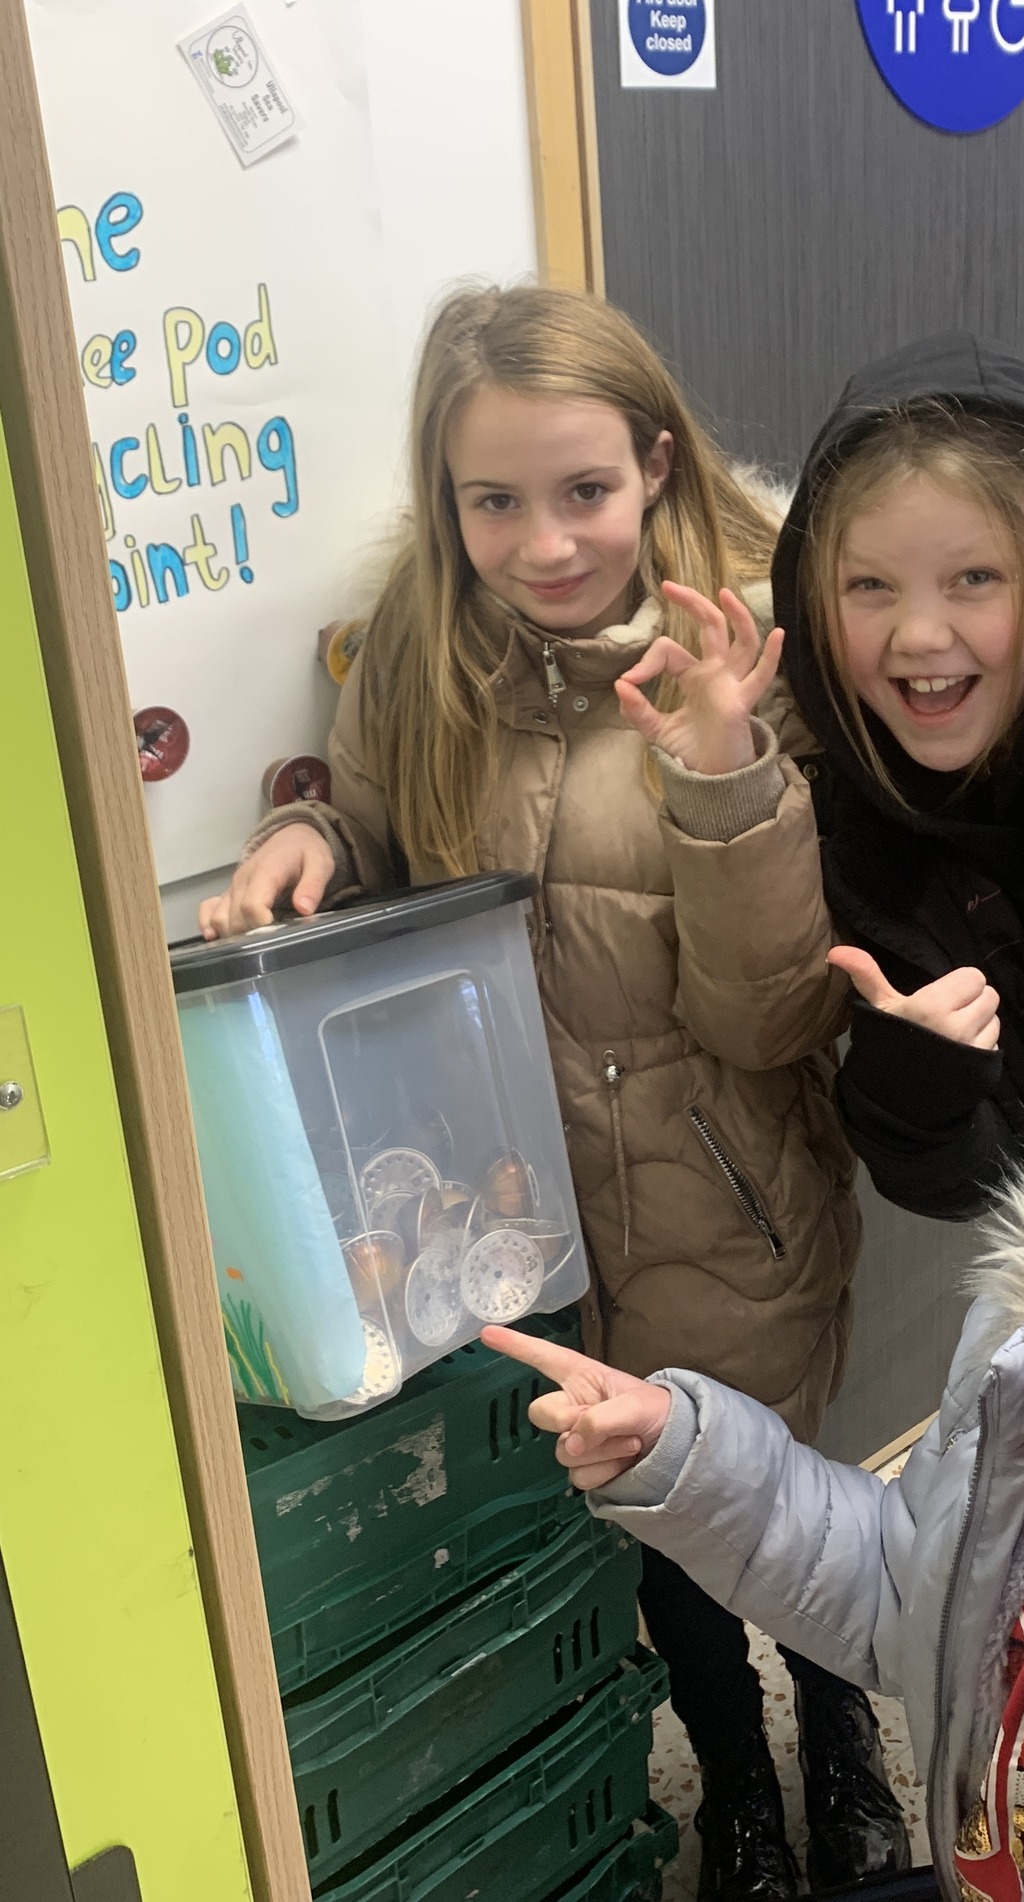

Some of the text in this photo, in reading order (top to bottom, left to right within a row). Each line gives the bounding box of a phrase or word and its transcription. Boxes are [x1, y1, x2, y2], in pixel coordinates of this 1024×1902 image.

[650, 9, 687, 32] Keep
[645, 32, 692, 51] closed
[81, 329, 136, 389] ee
[108, 503, 254, 612] oint!
